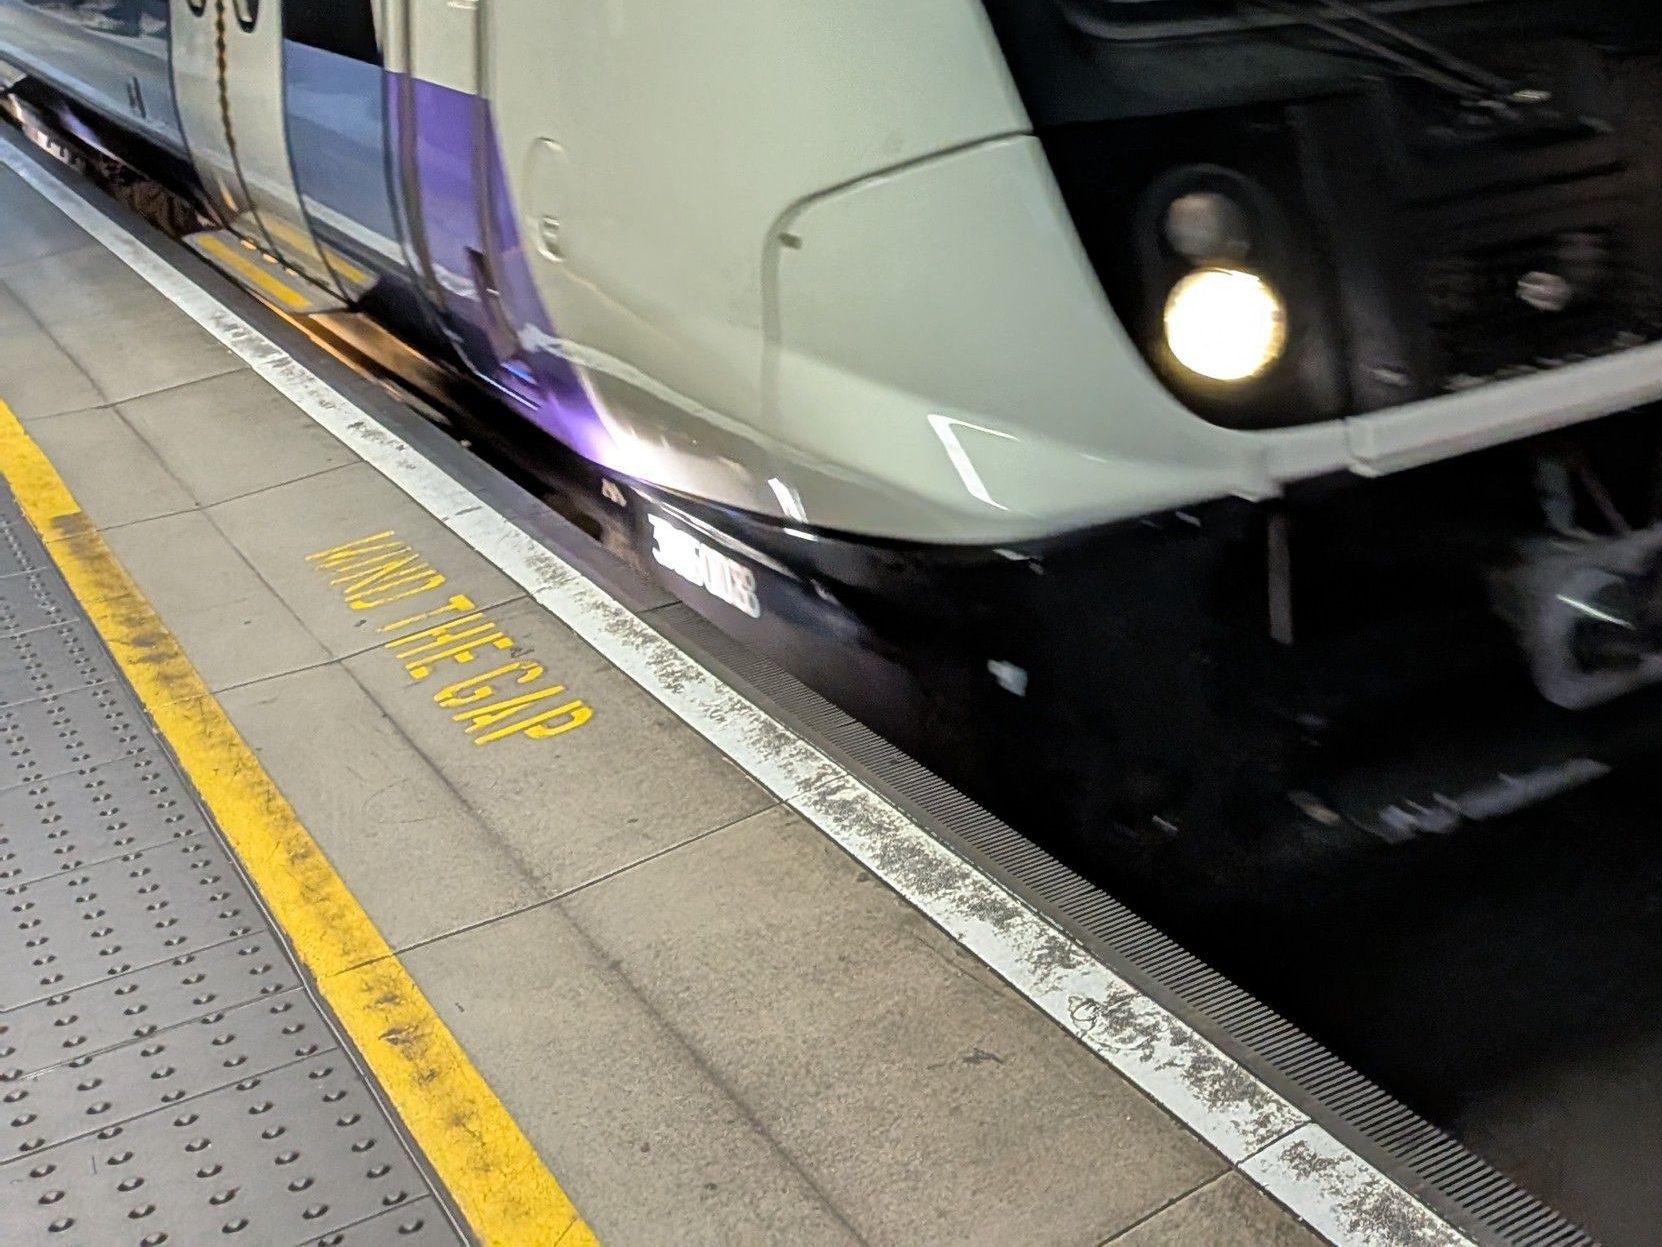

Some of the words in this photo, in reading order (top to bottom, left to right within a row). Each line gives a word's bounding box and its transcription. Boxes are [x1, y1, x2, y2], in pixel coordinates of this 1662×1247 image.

[305, 530, 446, 610] MIND
[376, 593, 513, 680] THE
[433, 659, 593, 746] GAP
